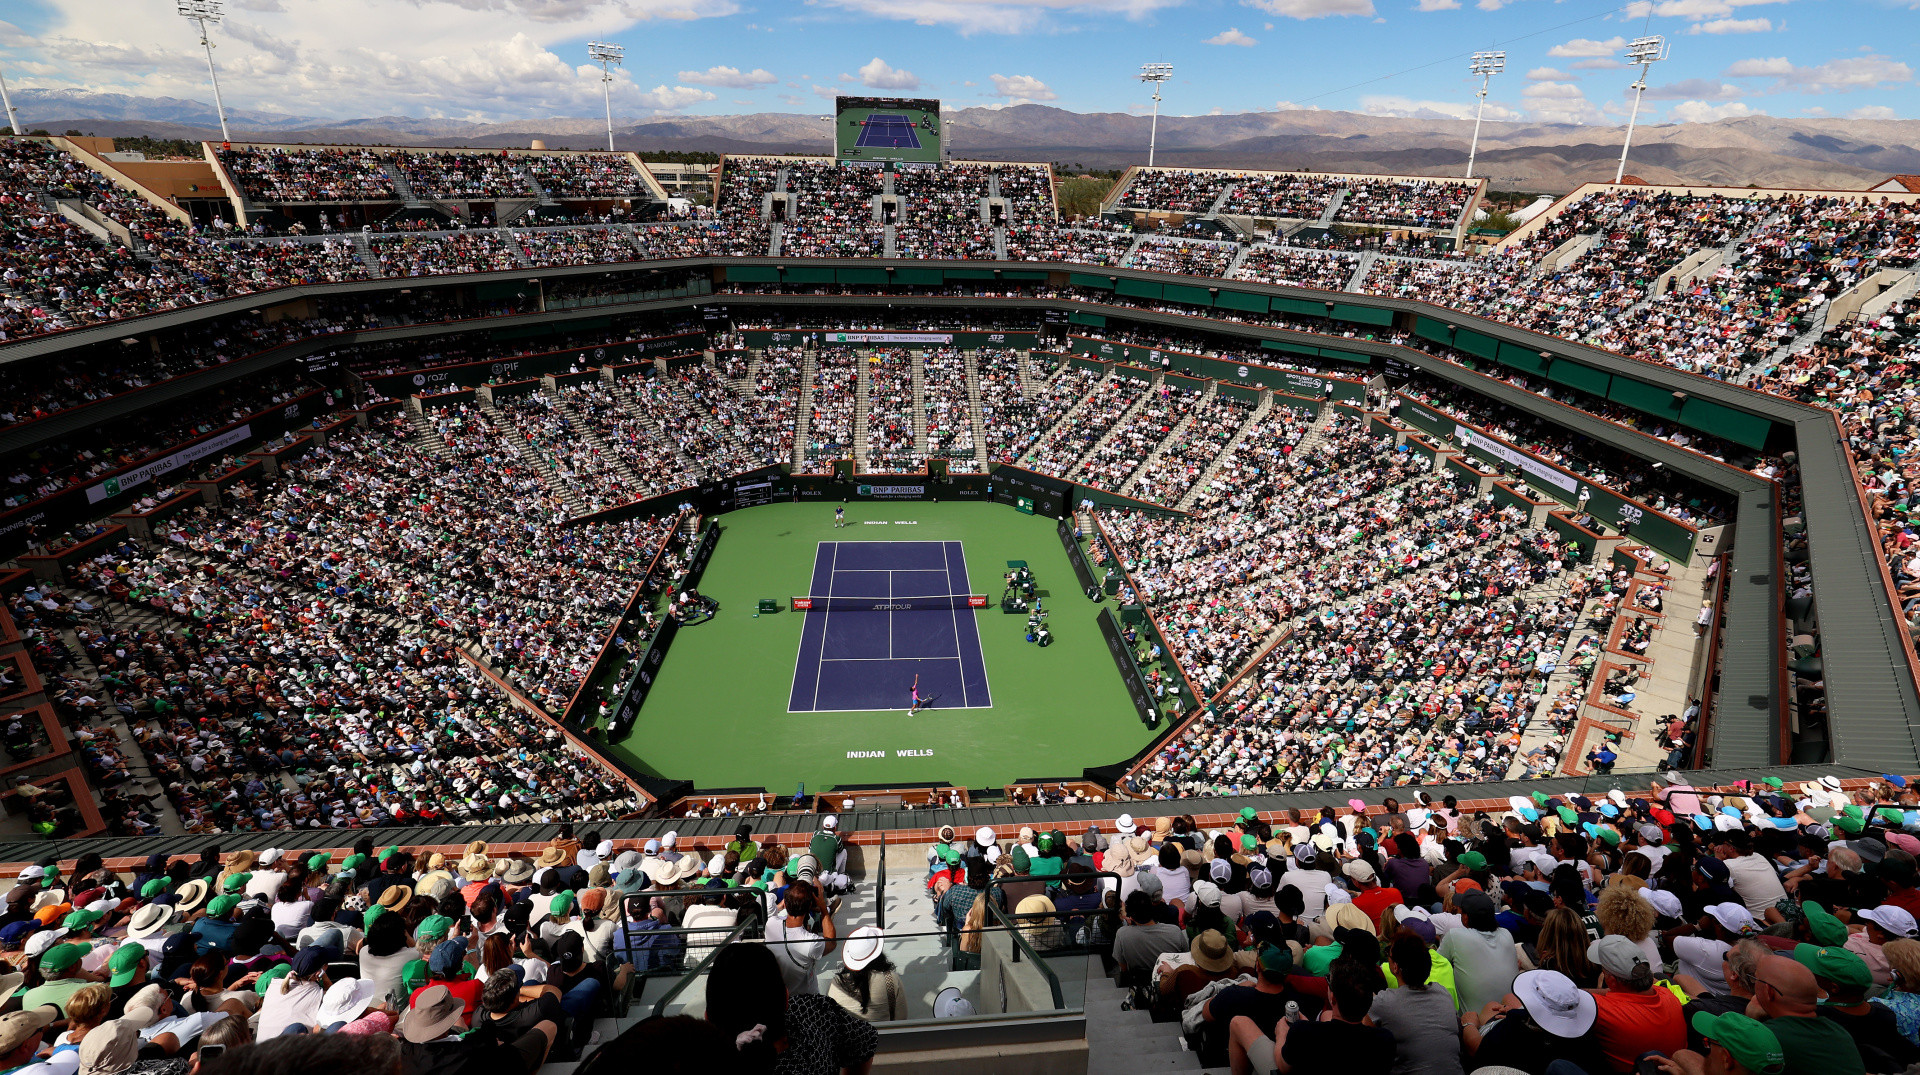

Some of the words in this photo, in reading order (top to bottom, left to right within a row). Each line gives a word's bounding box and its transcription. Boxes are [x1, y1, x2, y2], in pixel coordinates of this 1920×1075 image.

[647, 341, 677, 349] SEABOURN
[504, 362, 519, 371] PIF
[427, 372, 448, 382] razr
[1473, 436, 1483, 444] BNP
[1483, 441, 1505, 456] PARIBAS
[121, 474, 138, 486] BNP
[140, 460, 172, 480] PARIBAS
[1620, 503, 1643, 518] ATP
[896, 749, 934, 757] WELLS
